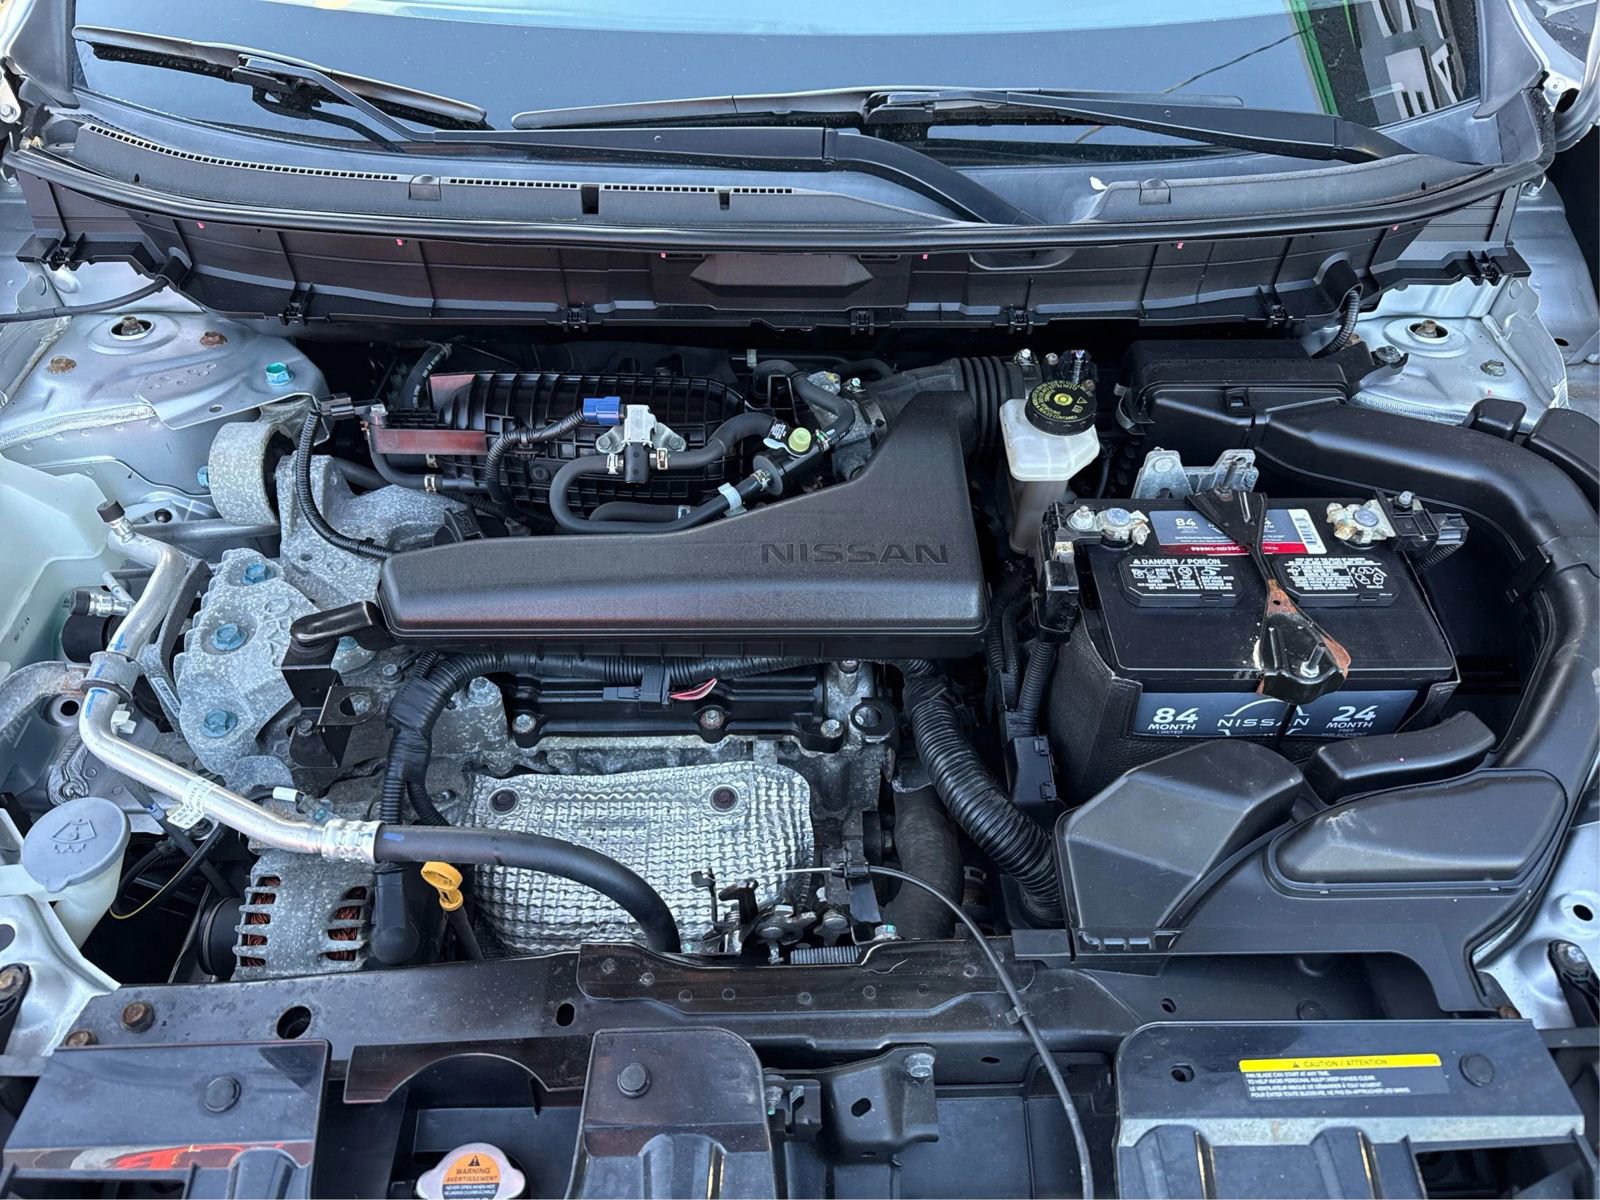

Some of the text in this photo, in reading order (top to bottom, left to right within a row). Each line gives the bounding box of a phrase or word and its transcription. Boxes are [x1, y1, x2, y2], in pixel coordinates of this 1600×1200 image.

[1175, 517, 1197, 526] 84
[760, 543, 949, 565] NISSAN
[1152, 707, 1200, 723] 84
[1331, 705, 1379, 722] 24
[1147, 723, 1197, 731] MONTH
[1325, 721, 1374, 729] MONTH
[1303, 1060, 1338, 1068] CAUTION
[1346, 1059, 1388, 1067] ATTENTION
[456, 1167, 491, 1175] WARNING
